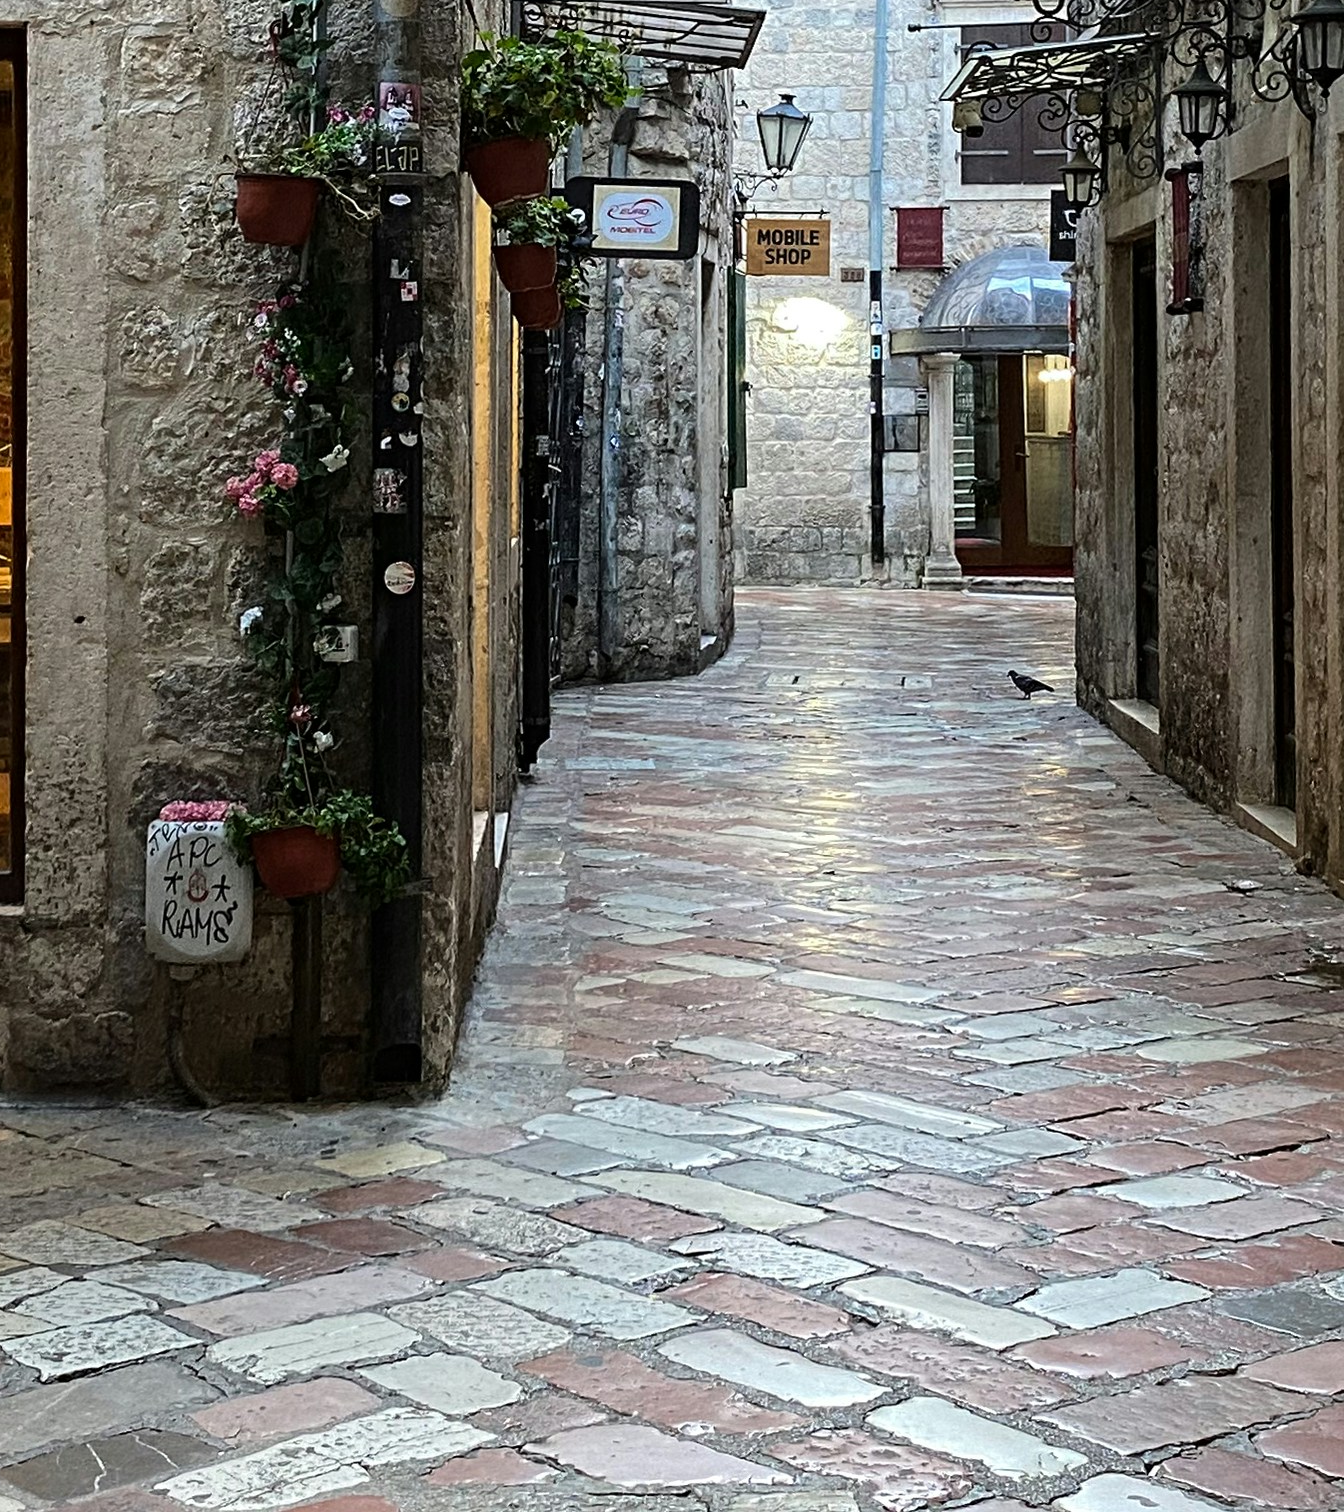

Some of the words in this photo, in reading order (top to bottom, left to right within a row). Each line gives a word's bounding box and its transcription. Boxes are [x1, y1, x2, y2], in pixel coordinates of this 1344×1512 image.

[619, 208, 650, 216] EURO
[757, 228, 820, 246] MOBILE
[764, 248, 811, 265] SHOP
